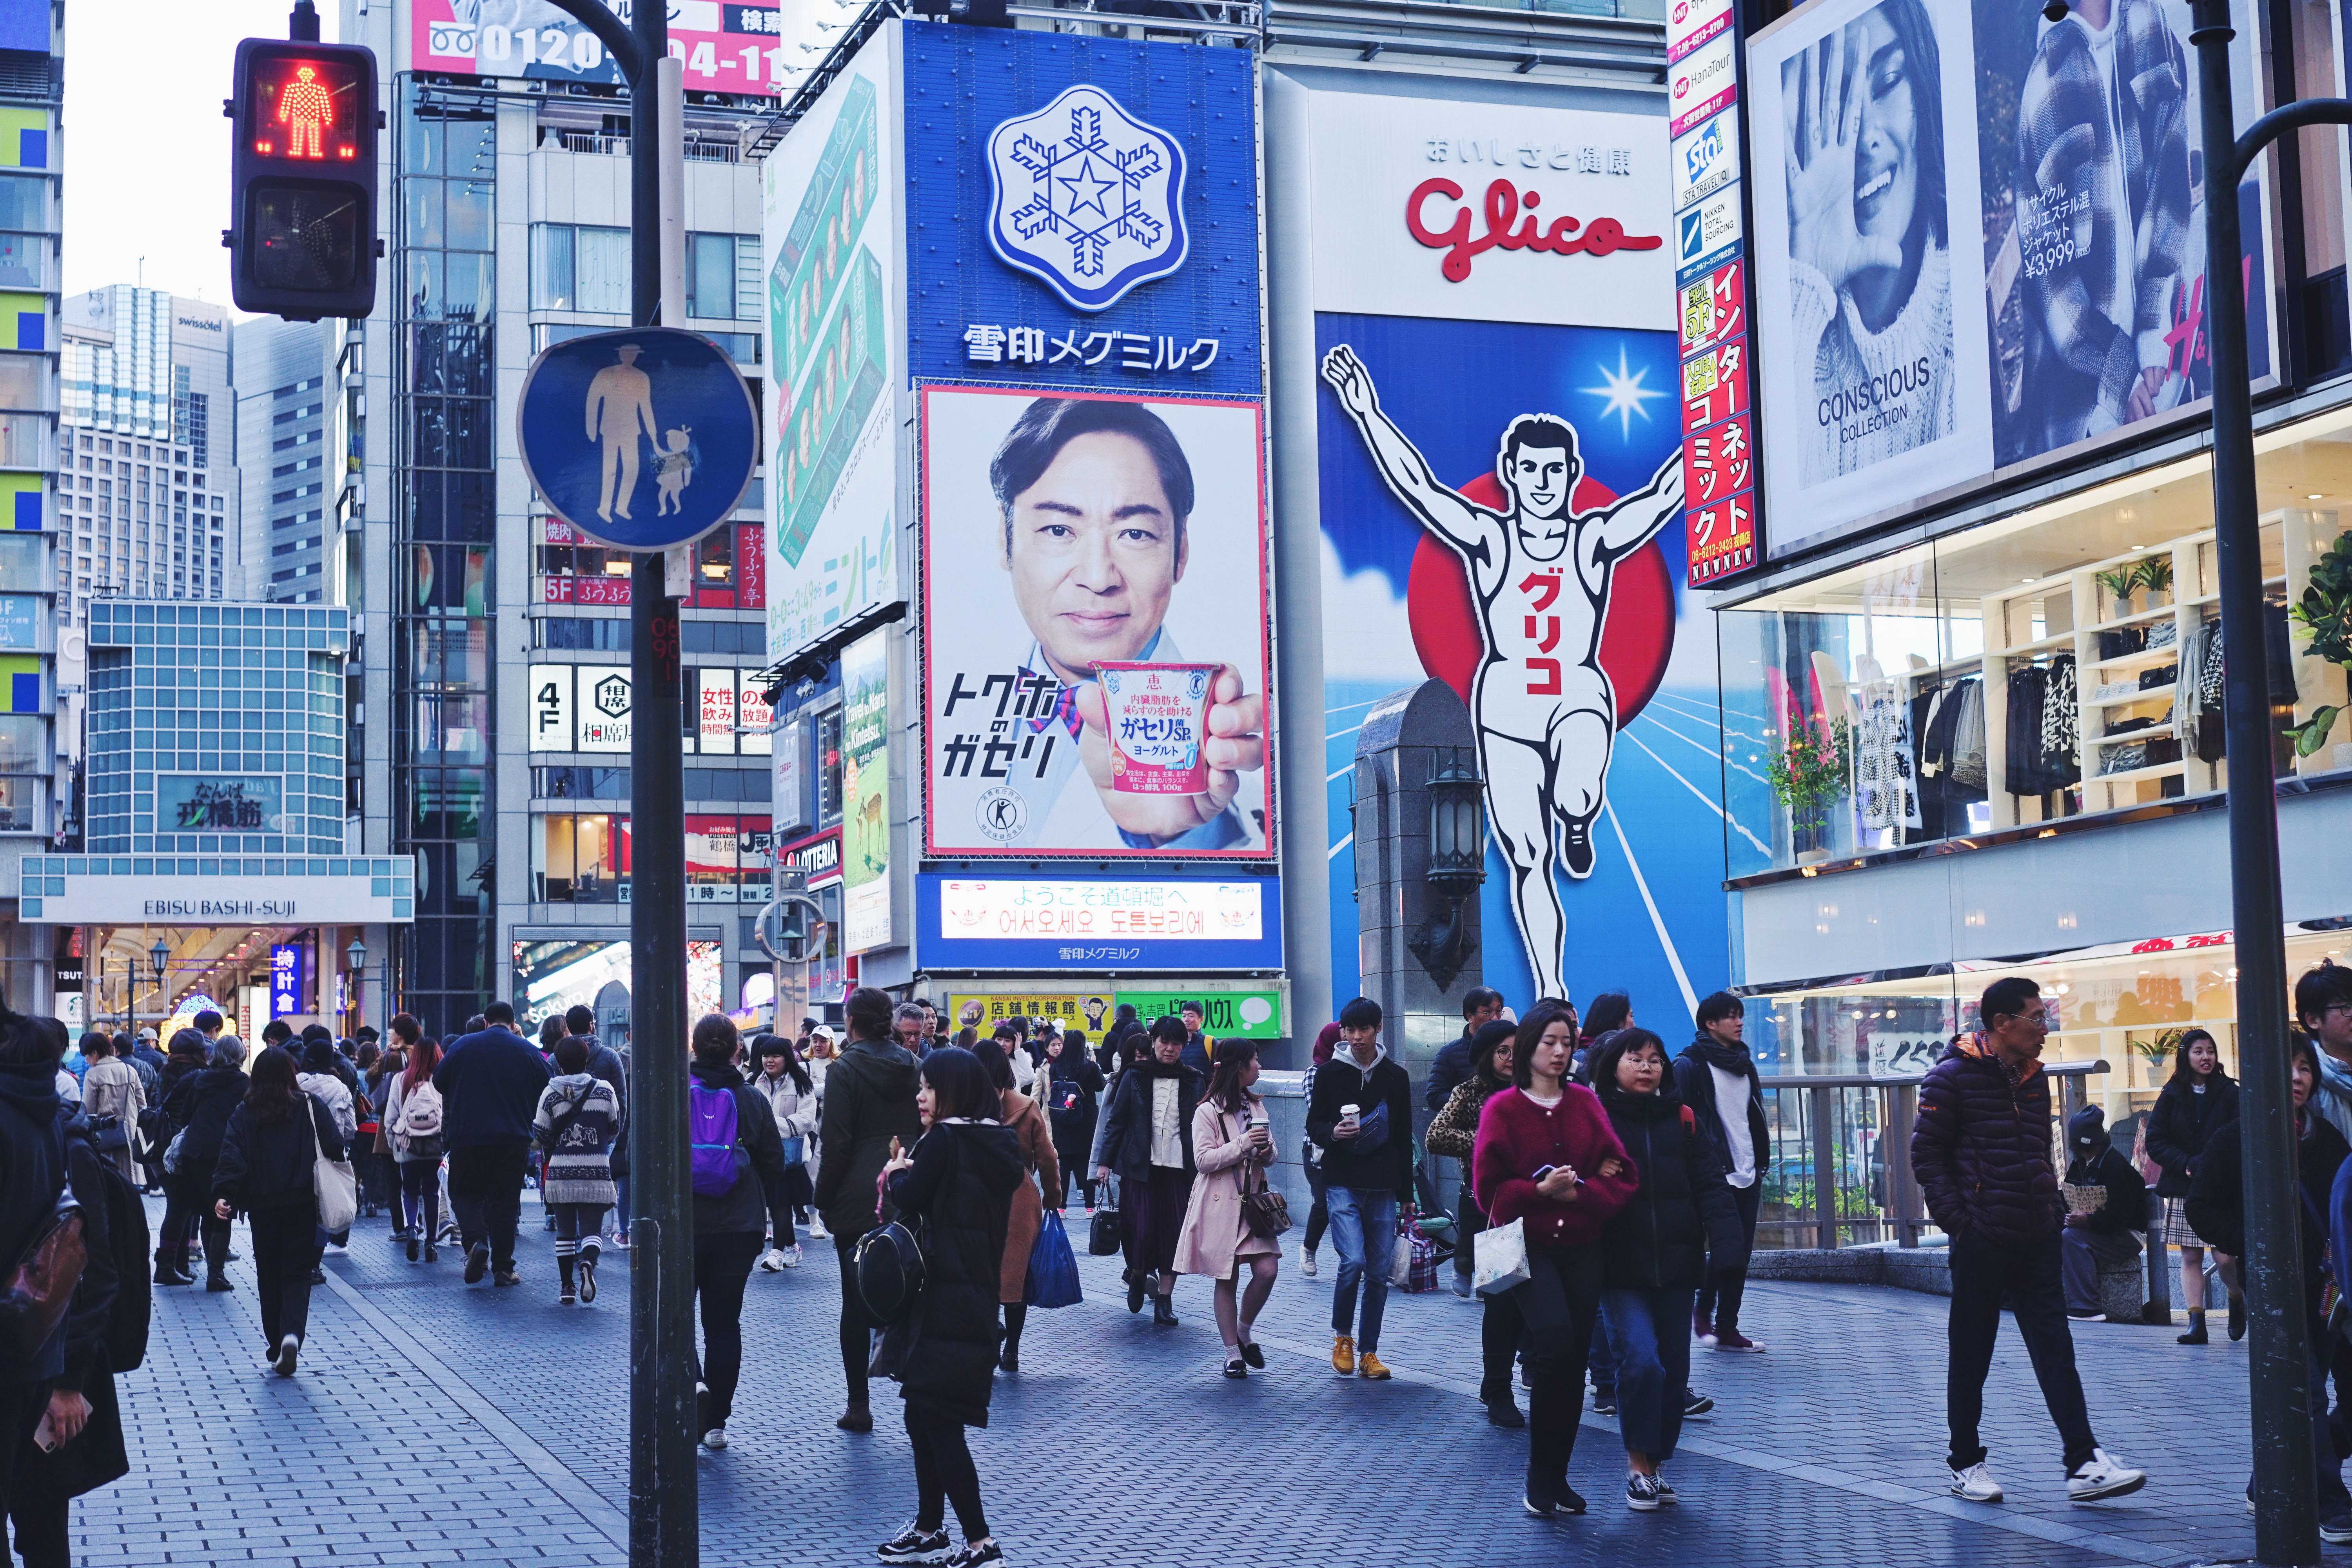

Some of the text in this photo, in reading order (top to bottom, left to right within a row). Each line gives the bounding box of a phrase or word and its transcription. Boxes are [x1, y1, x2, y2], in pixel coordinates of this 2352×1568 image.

[741, 9, 780, 33] 検索
[1677, 17, 1724, 56] T.06-6213-8700
[1691, 54, 1730, 88] HanaTour
[1683, 96, 1723, 129] 大阪営業所 11F
[1426, 133, 1633, 175] おいしさと健康
[1690, 119, 1723, 176] sta TRAVEL
[1684, 176, 1718, 204] STA TRAVEL
[2022, 182, 2066, 215] リサイクル
[1704, 202, 1725, 220] NIKKEN
[1705, 215, 1722, 230] TOTAL
[2023, 190, 2090, 235] ポリエステル混
[1406, 178, 1663, 282] Glico
[1705, 220, 1734, 242] SOURCING
[2024, 222, 2070, 256] ジャケット
[2024, 240, 2074, 279] ¥3,999
[1689, 282, 1708, 306] 当ビル
[1686, 298, 1712, 339] 5F
[964, 323, 1219, 371] 雪印メグミルク
[1686, 356, 1710, 382] 入口は
[1690, 374, 1707, 397] 右奥
[1818, 357, 1929, 426] CONSCIOUS
[1715, 262, 1749, 537] インターネット
[1842, 403, 1907, 443] COLLECTION
[1689, 395, 1717, 548] コミック
[546, 522, 571, 541] 焼肉
[1691, 531, 1751, 563] 06-6212-2423 戎橋店
[744, 528, 761, 606] ふうふう亭
[546, 579, 572, 600] 5F
[1518, 567, 1564, 695] グリコ
[1146, 673, 1164, 690] 恵
[537, 682, 560, 733] 4F
[604, 685, 626, 707] 相席
[702, 688, 734, 705] 女性
[845, 691, 886, 725] Travel to Nara
[943, 672, 1060, 719] トクホ
[1131, 694, 1181, 705] 内臓脂肪を
[702, 707, 768, 723] 飲み 放題
[1123, 704, 1192, 717] 減らすのを助ける
[845, 722, 880, 753] on Kintetsu.
[991, 720, 1008, 733] の
[1120, 717, 1174, 742] ガセリ
[942, 733, 1057, 779] ガセリ
[1134, 745, 1179, 757] ヨーグルト
[982, 788, 1021, 802] 消費者庁許可
[1132, 783, 1182, 792] はっ酵乳 100g
[981, 824, 1023, 840] 特定保健用食品
[710, 839, 736, 852] 鶴橋
[796, 839, 838, 873] LOTTERIA
[620, 887, 632, 900] 営
[742, 891, 757, 899] 翌朝
[1014, 886, 1188, 907] ようこそ道頓堀へ
[144, 900, 296, 918] EBISU BASHI-SUJI
[999, 910, 1204, 934] 어서오세요 도톤보리에
[1058, 947, 1140, 960] 雪印メグミルク
[277, 949, 295, 1019] 時計倉
[528, 990, 586, 1024] Sakura
[991, 1001, 1075, 1015] 店舗情報館
